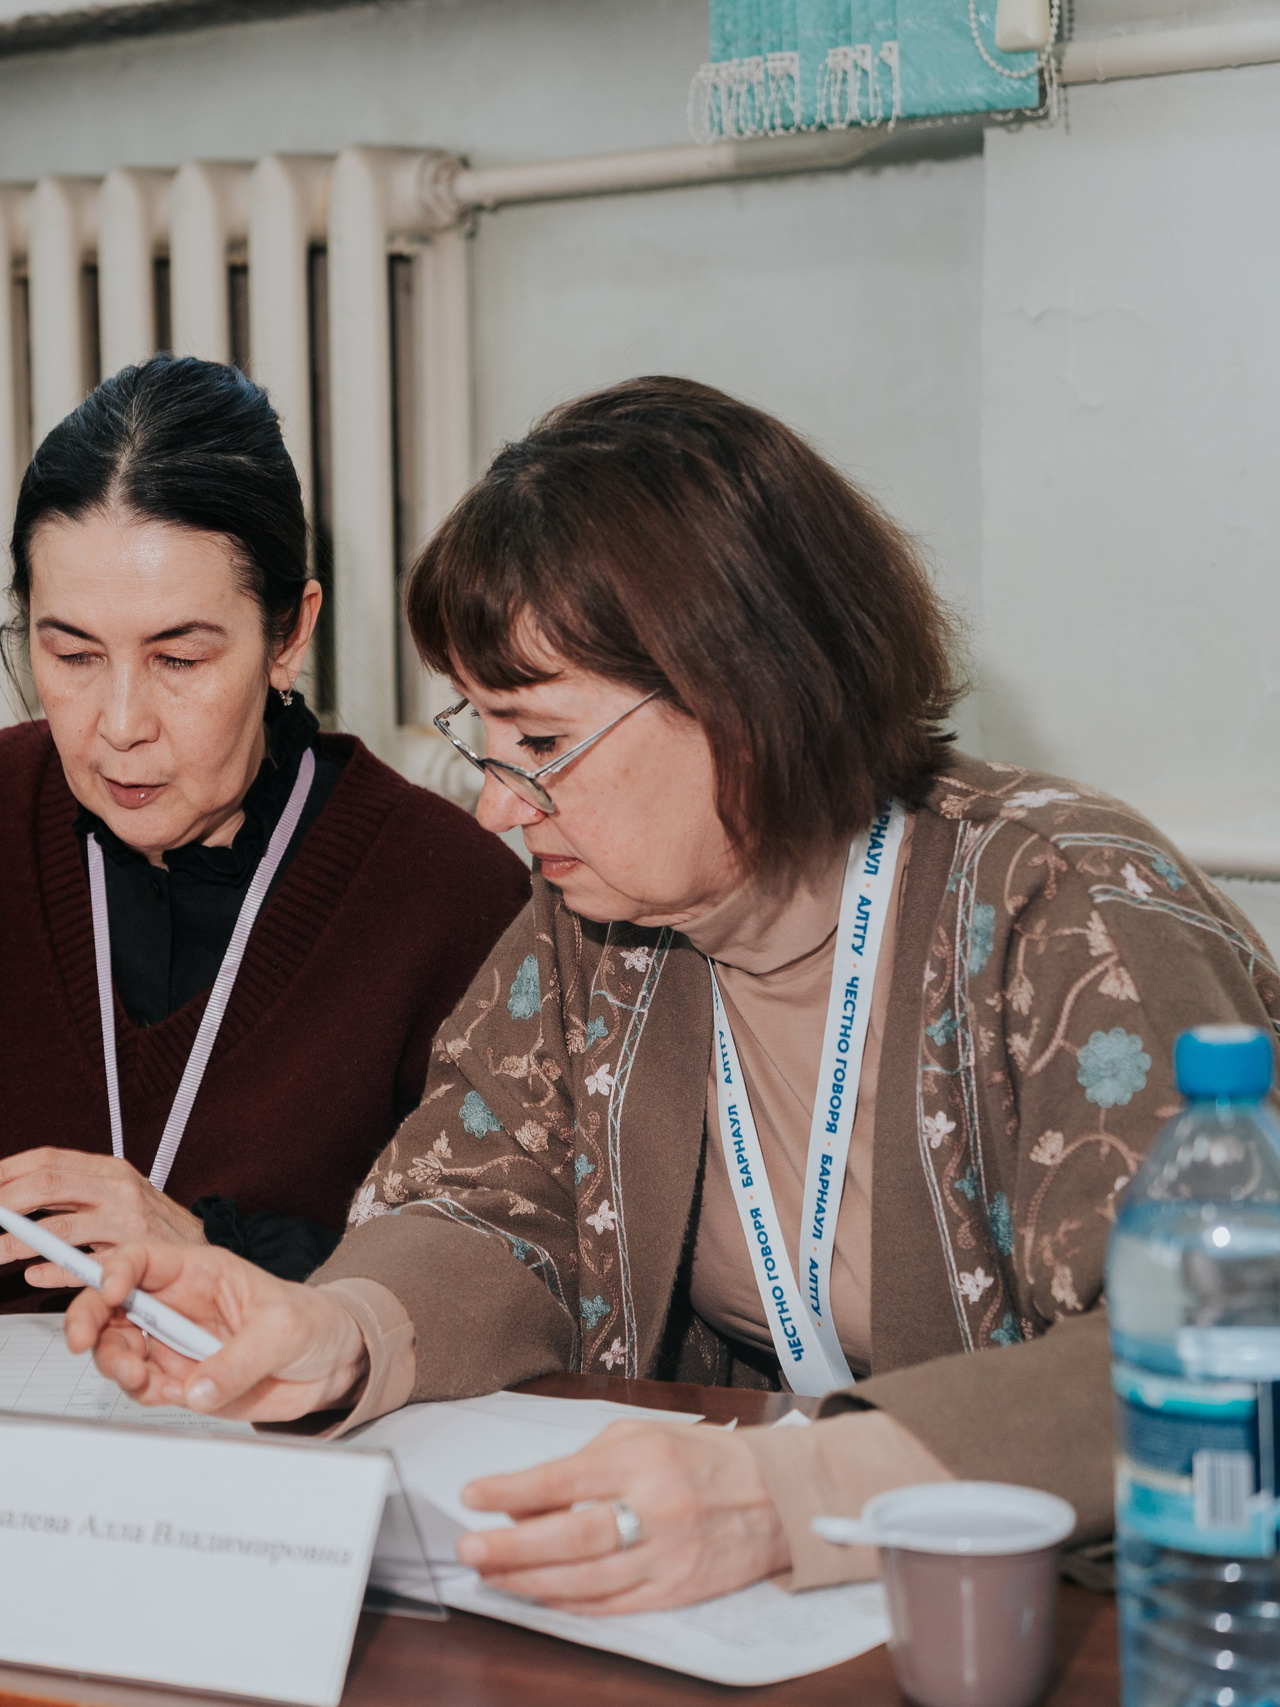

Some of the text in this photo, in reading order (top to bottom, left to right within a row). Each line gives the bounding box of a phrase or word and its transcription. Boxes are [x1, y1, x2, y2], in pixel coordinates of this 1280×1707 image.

[851, 894, 872, 957] АЛТГУ
[837, 976, 859, 1054] ЧЕСТНО
[825, 1058, 847, 1134] ГОВОРЯ
[718, 1030, 805, 1362] ЧЕСТНО ГОВОРЯ БАРНАУЛ АЛТГУ
[812, 1153, 833, 1240] БАРНАУЛ
[809, 1257, 822, 1317] АЛТГУ
[77, 1513, 145, 1546] Алла
[150, 1521, 355, 1569] Владимировна
